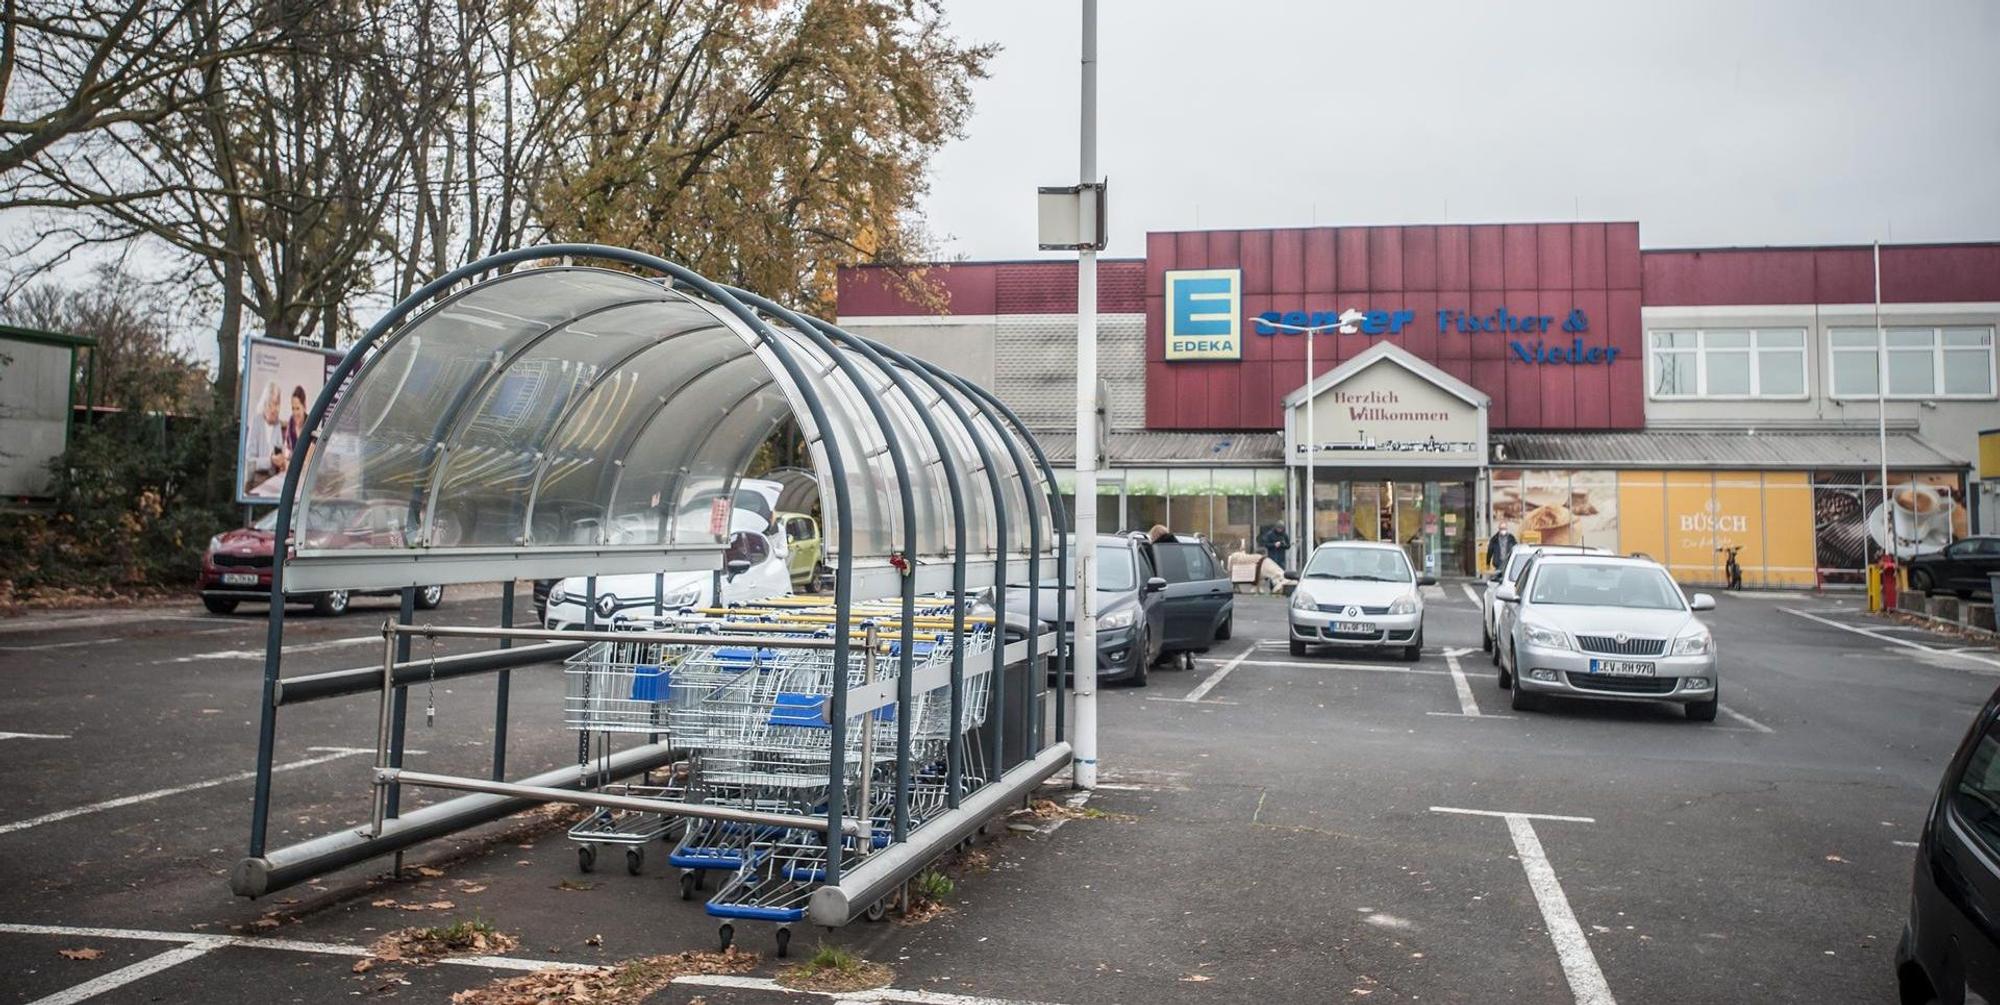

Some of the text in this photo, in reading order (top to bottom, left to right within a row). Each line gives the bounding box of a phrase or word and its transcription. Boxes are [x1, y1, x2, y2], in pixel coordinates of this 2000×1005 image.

[1436, 307, 1590, 334] Fischer &
[1173, 341, 1233, 352] EDEKA
[1510, 337, 1620, 365] Nieder
[1334, 391, 1399, 404] Herzlich
[1350, 406, 1449, 421] Willkommen
[1680, 512, 1747, 531] BÜSCH
[1598, 661, 1616, 672] LEV
[1636, 664, 1653, 674] 970
